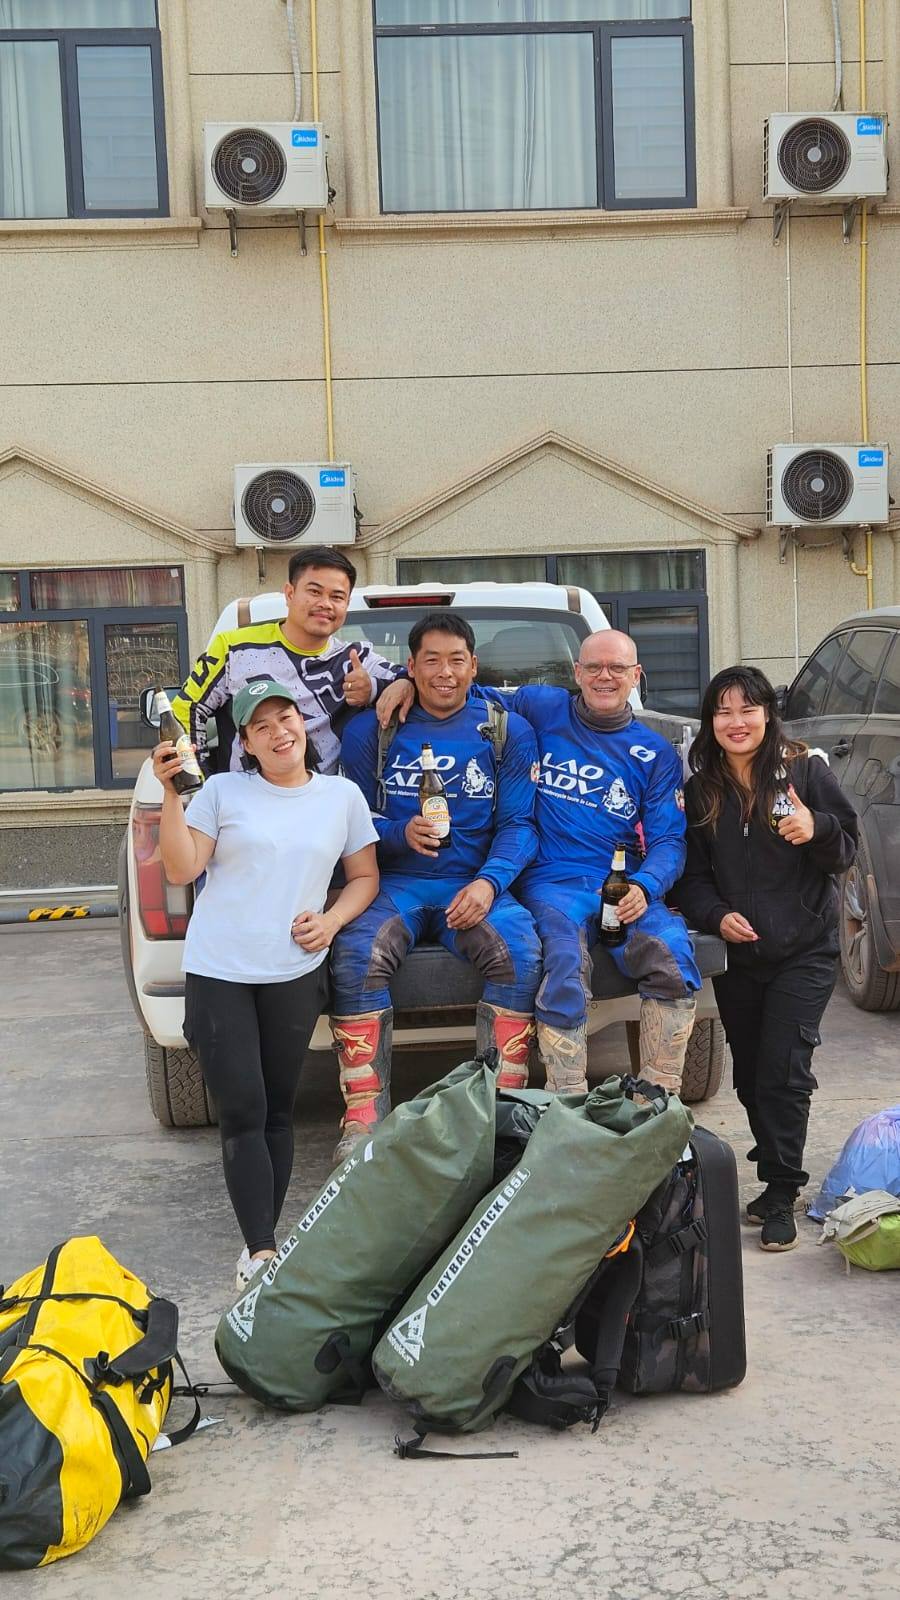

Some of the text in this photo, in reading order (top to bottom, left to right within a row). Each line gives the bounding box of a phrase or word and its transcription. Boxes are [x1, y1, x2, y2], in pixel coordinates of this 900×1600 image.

[296, 134, 316, 143] Midea
[862, 455, 882, 463] Midea
[542, 752, 604, 780] LAO
[539, 770, 604, 795] ADV
[429, 1169, 530, 1302] DRYBACKPACK 65L
